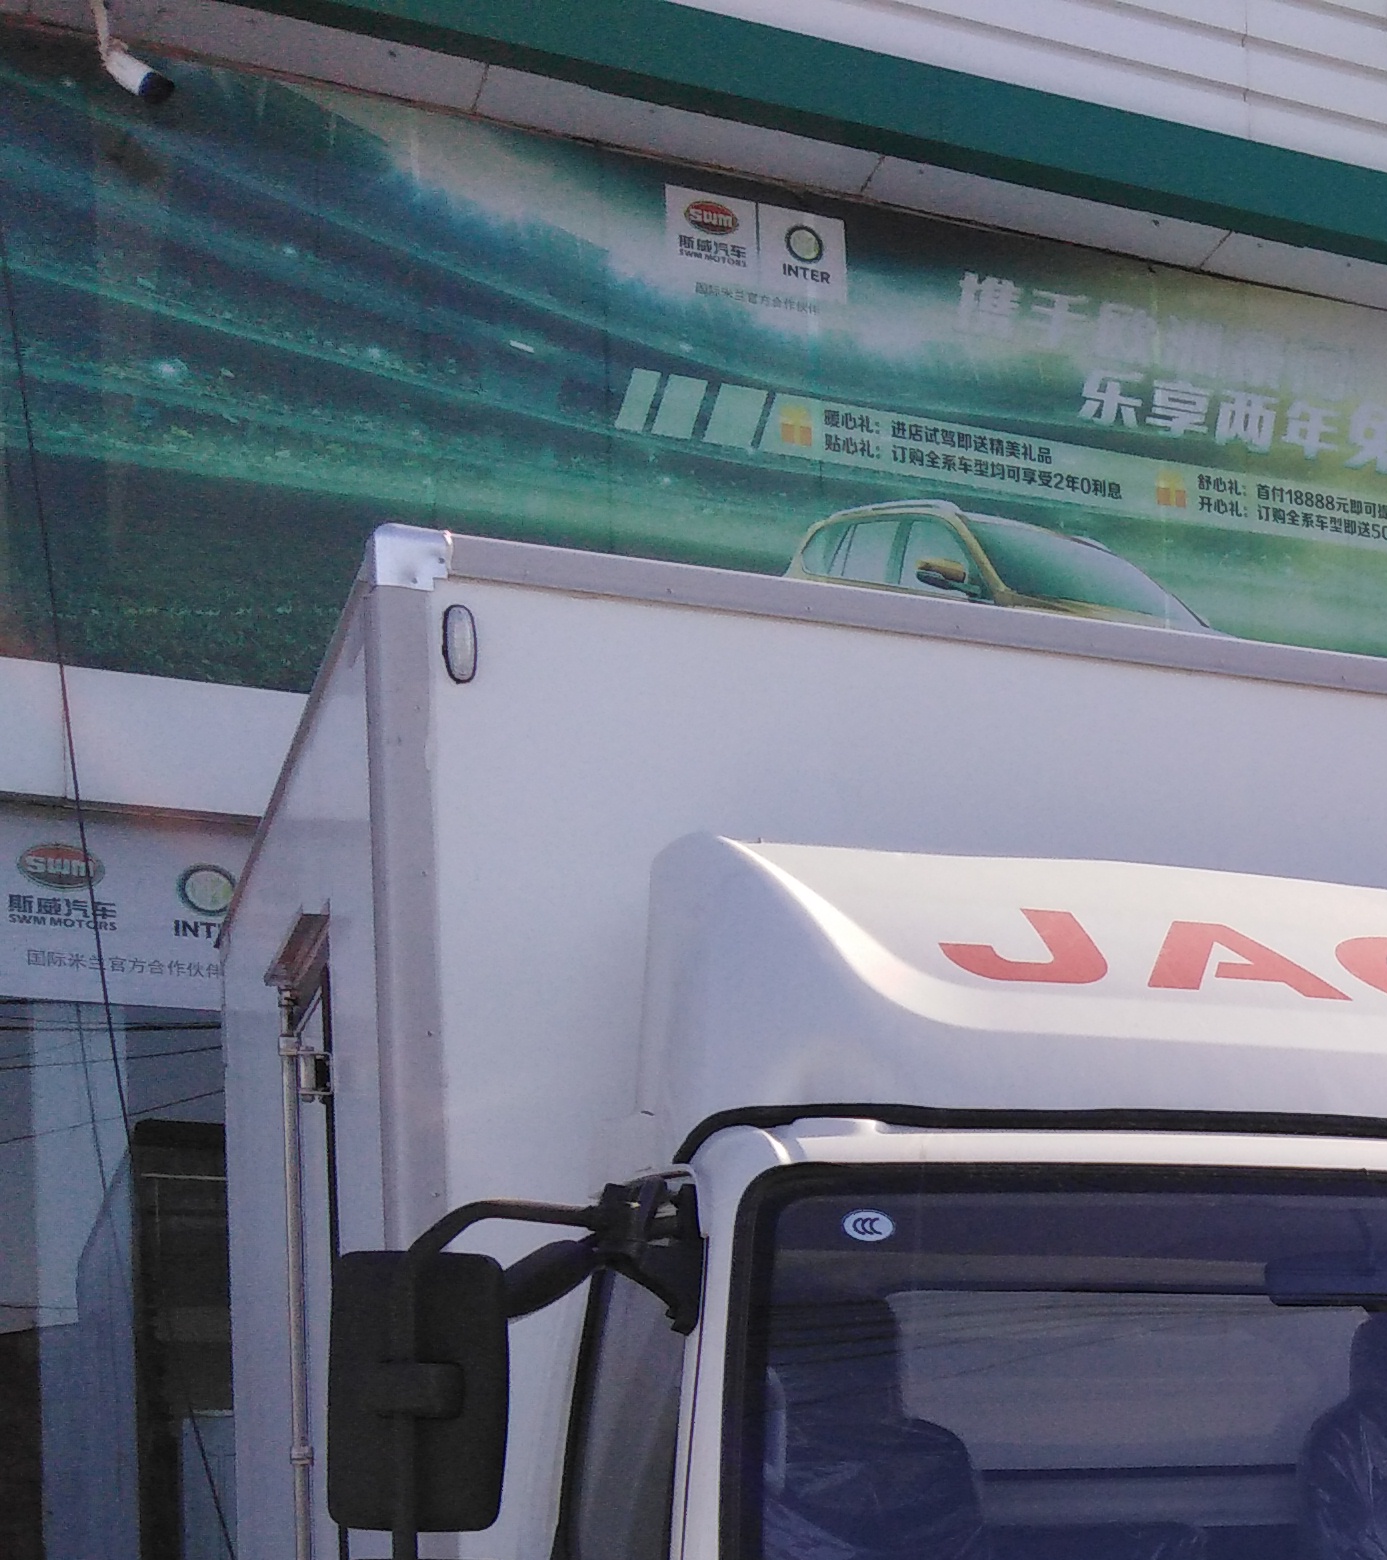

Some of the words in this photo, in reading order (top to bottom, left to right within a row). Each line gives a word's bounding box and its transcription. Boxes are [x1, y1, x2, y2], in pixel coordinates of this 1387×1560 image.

[782, 263, 831, 284] INTER
[8, 894, 117, 920] 斯威汽车
[8, 913, 46, 926] SWM
[50, 917, 117, 932] MOTORS
[174, 919, 220, 940] INT
